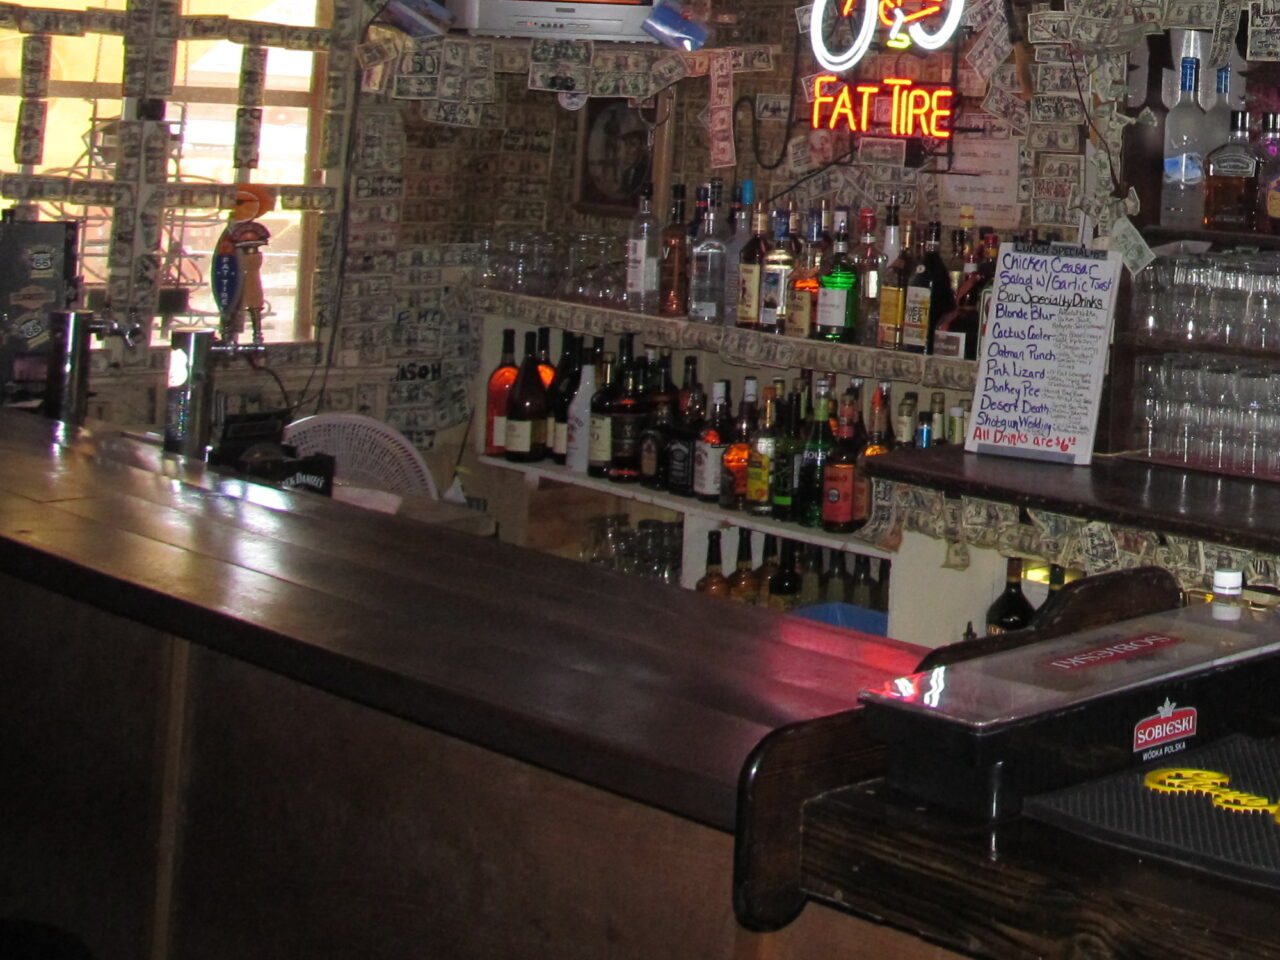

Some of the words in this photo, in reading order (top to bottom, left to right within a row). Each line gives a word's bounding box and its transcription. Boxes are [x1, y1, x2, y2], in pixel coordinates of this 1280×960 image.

[812, 75, 880, 132] FAT
[882, 77, 954, 138] TIRE
[1002, 252, 1049, 273] Chicken
[999, 270, 1034, 287] Salad
[996, 285, 1021, 303] Bar
[1072, 292, 1104, 310] Drinks
[995, 303, 1029, 321] Blonde
[1029, 304, 1057, 321] Blur
[991, 322, 1027, 341] Cactus
[987, 342, 1025, 361] Oatman
[1025, 343, 1057, 361] Punch
[986, 359, 1010, 377] Pink
[1012, 361, 1046, 380] Lizard
[983, 377, 1021, 401] Donkey
[1021, 380, 1042, 398] Pee
[980, 394, 1019, 413] Desert
[1021, 399, 1050, 416] Death
[975, 411, 1020, 433] Shotgun
[972, 426, 990, 441] All
[993, 429, 1029, 446] Drinks
[1032, 436, 1054, 448] are
[1136, 714, 1195, 745] SOBIESKI
[1164, 741, 1187, 757] POLSKA
